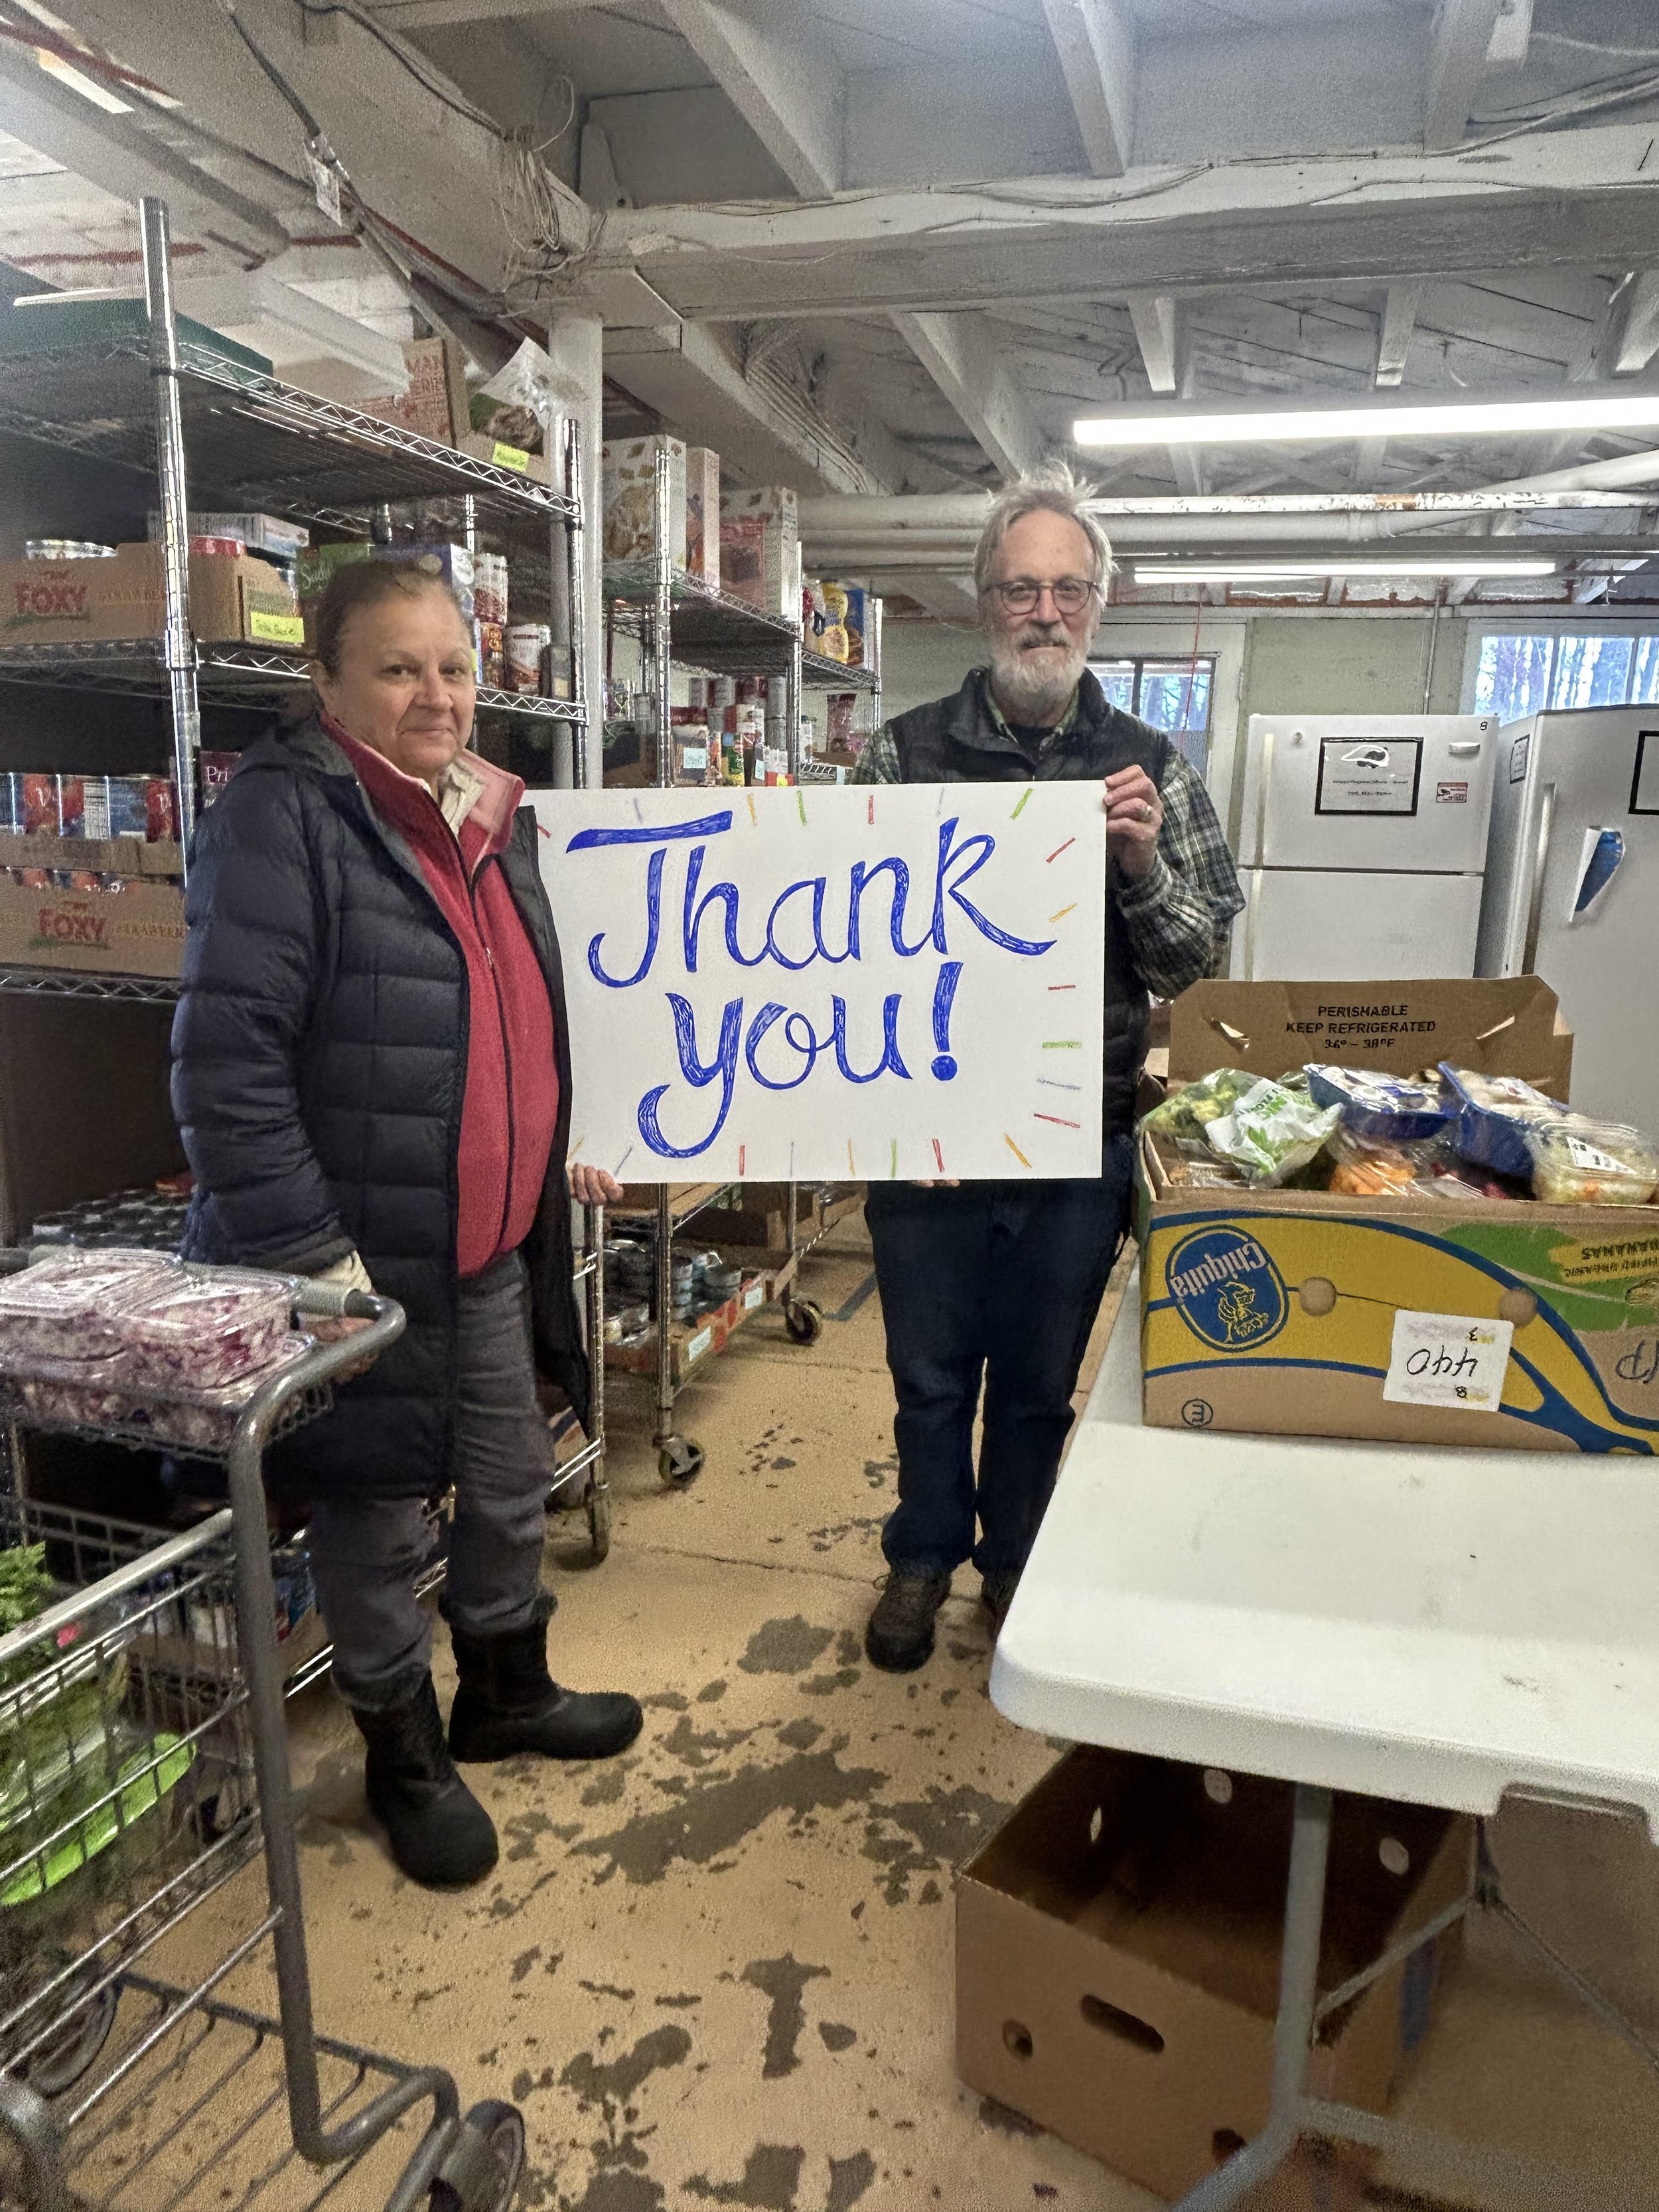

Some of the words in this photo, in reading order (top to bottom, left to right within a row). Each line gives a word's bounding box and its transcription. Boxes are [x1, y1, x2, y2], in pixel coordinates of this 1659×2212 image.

[566, 810, 1058, 988] Thank
[1286, 1022, 1324, 1033] KEEP
[1328, 1020, 1436, 1034] REFRIGERATED
[1318, 1005, 1409, 1018] PERISHABLE
[638, 962, 964, 1159] you!
[1170, 1242, 1267, 1297] Chiquita
[1406, 1345, 1479, 1378] 440
